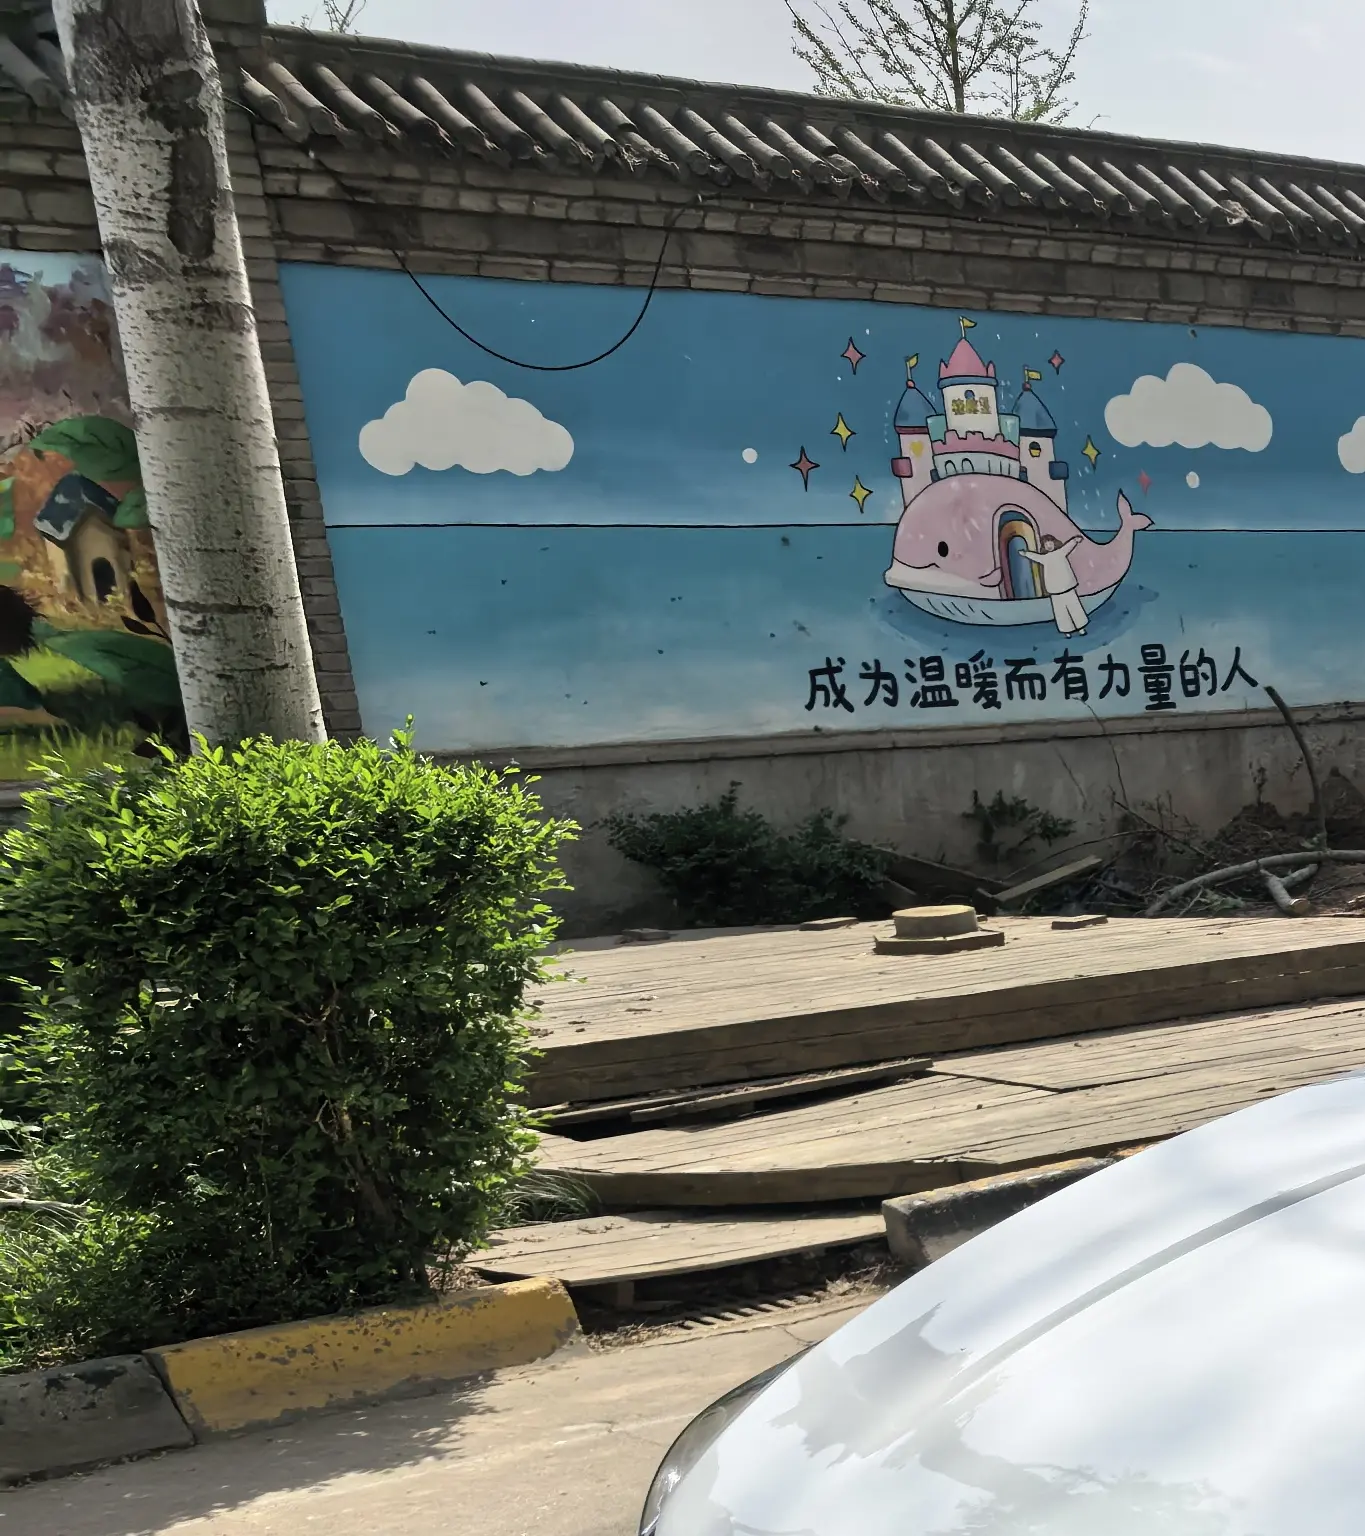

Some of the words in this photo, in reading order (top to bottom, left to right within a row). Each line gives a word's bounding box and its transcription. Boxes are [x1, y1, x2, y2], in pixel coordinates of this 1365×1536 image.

[805, 643, 1260, 713] 成为温暖而有力量的人
